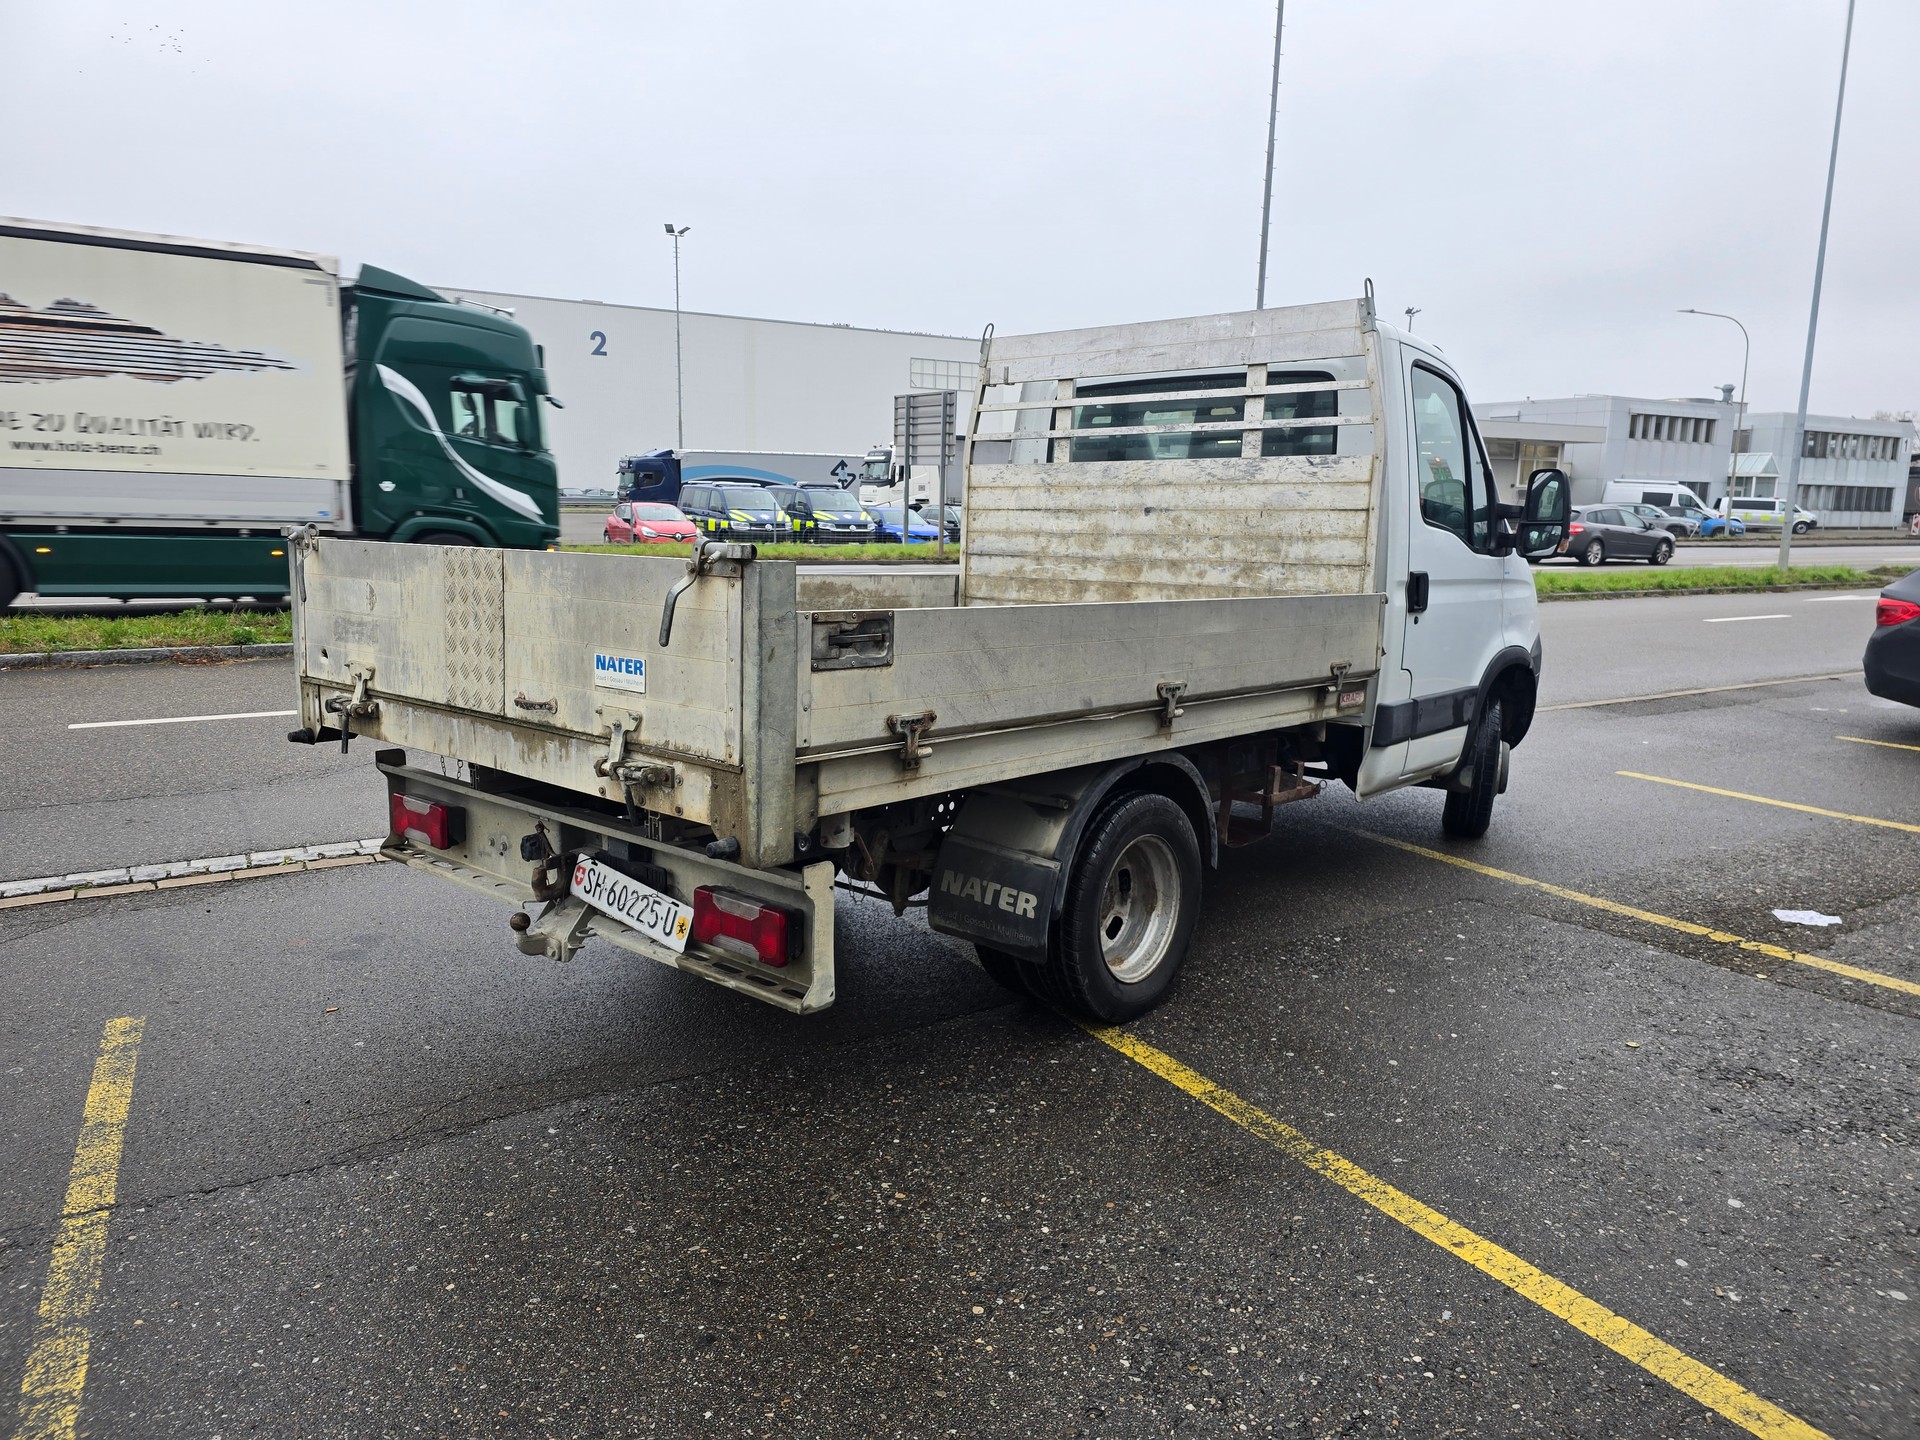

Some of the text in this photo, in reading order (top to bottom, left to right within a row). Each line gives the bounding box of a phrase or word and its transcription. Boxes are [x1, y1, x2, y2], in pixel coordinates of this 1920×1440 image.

[590, 331, 607, 356] 2
[74, 411, 187, 438] QUALITÄT
[595, 654, 644, 676] NATER
[940, 869, 1038, 919] NATER
